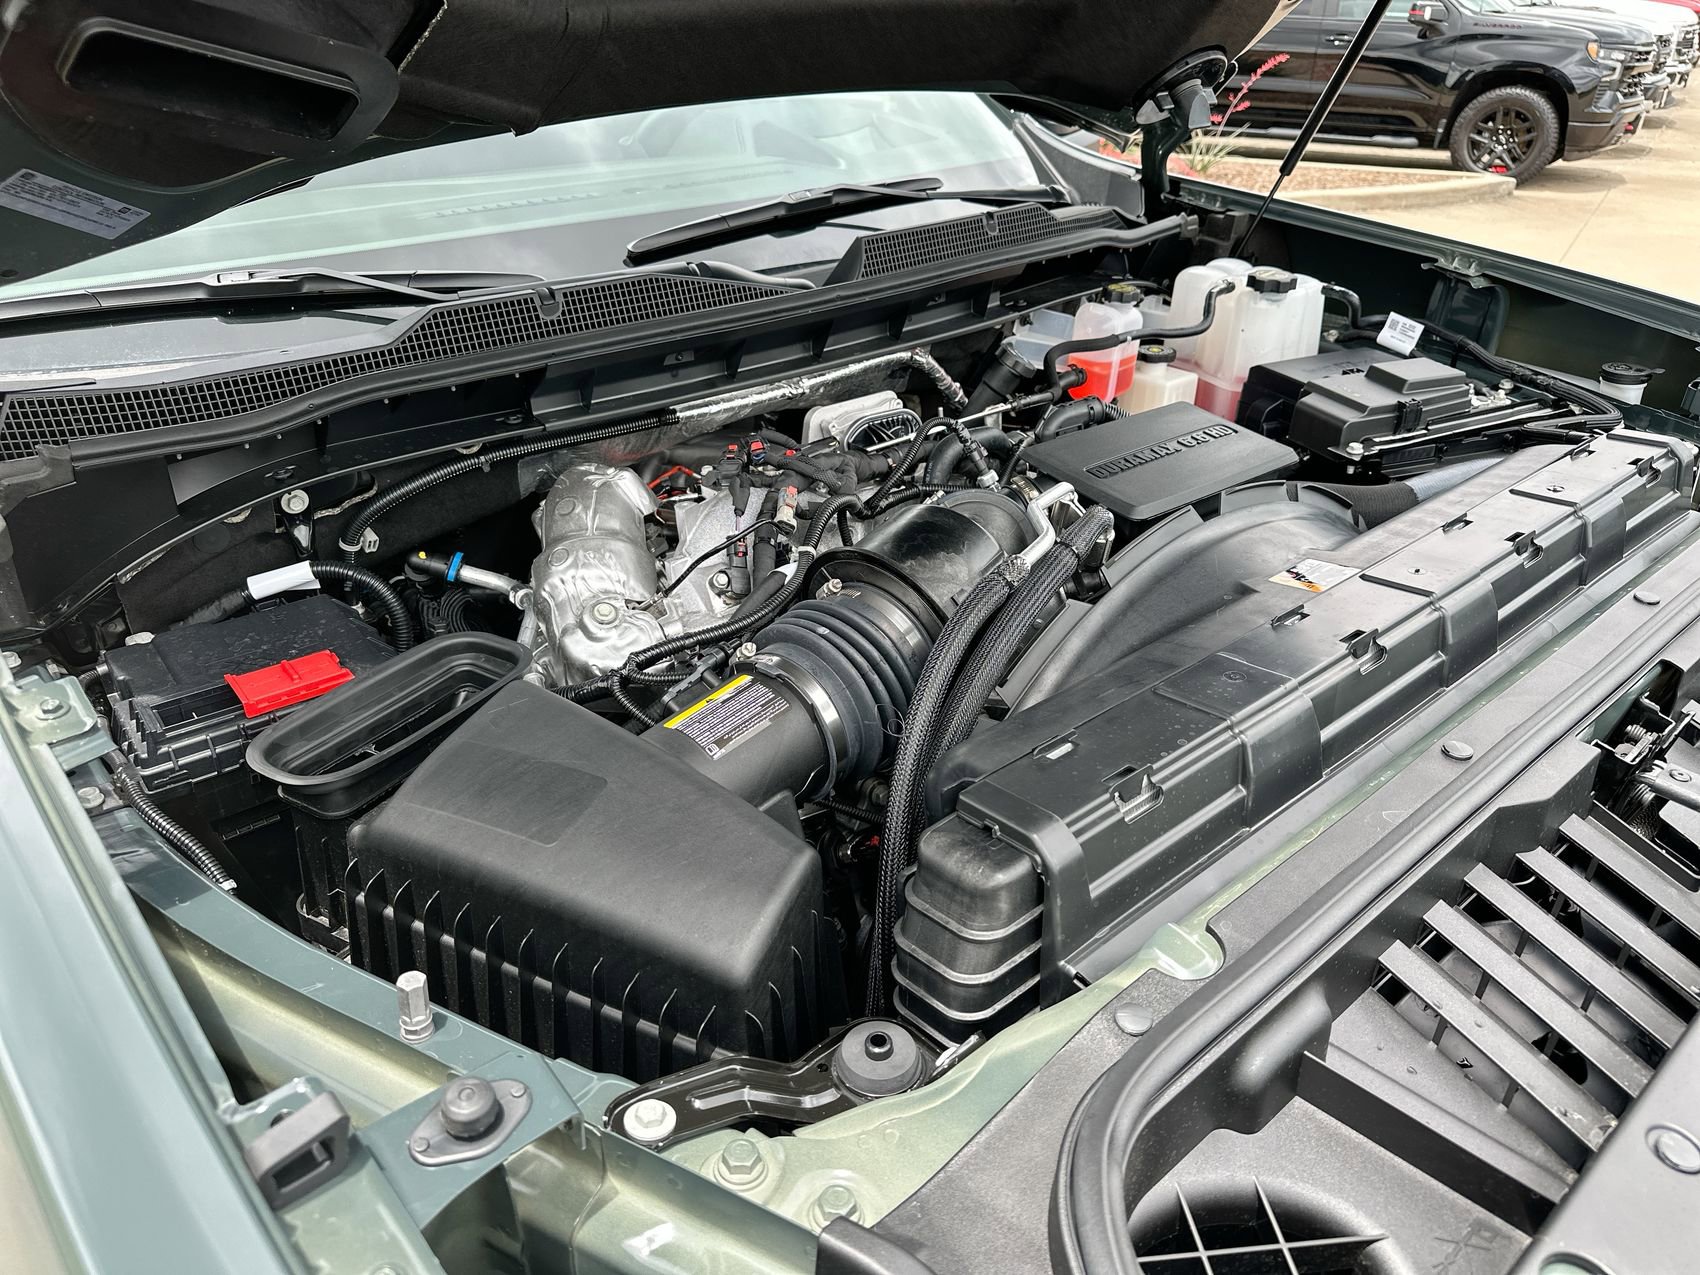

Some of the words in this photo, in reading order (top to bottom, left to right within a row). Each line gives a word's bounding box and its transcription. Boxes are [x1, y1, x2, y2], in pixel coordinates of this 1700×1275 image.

[1089, 443, 1180, 479] DURAMAX
[1177, 431, 1210, 448] 6.6
[1205, 424, 1235, 439] HD
